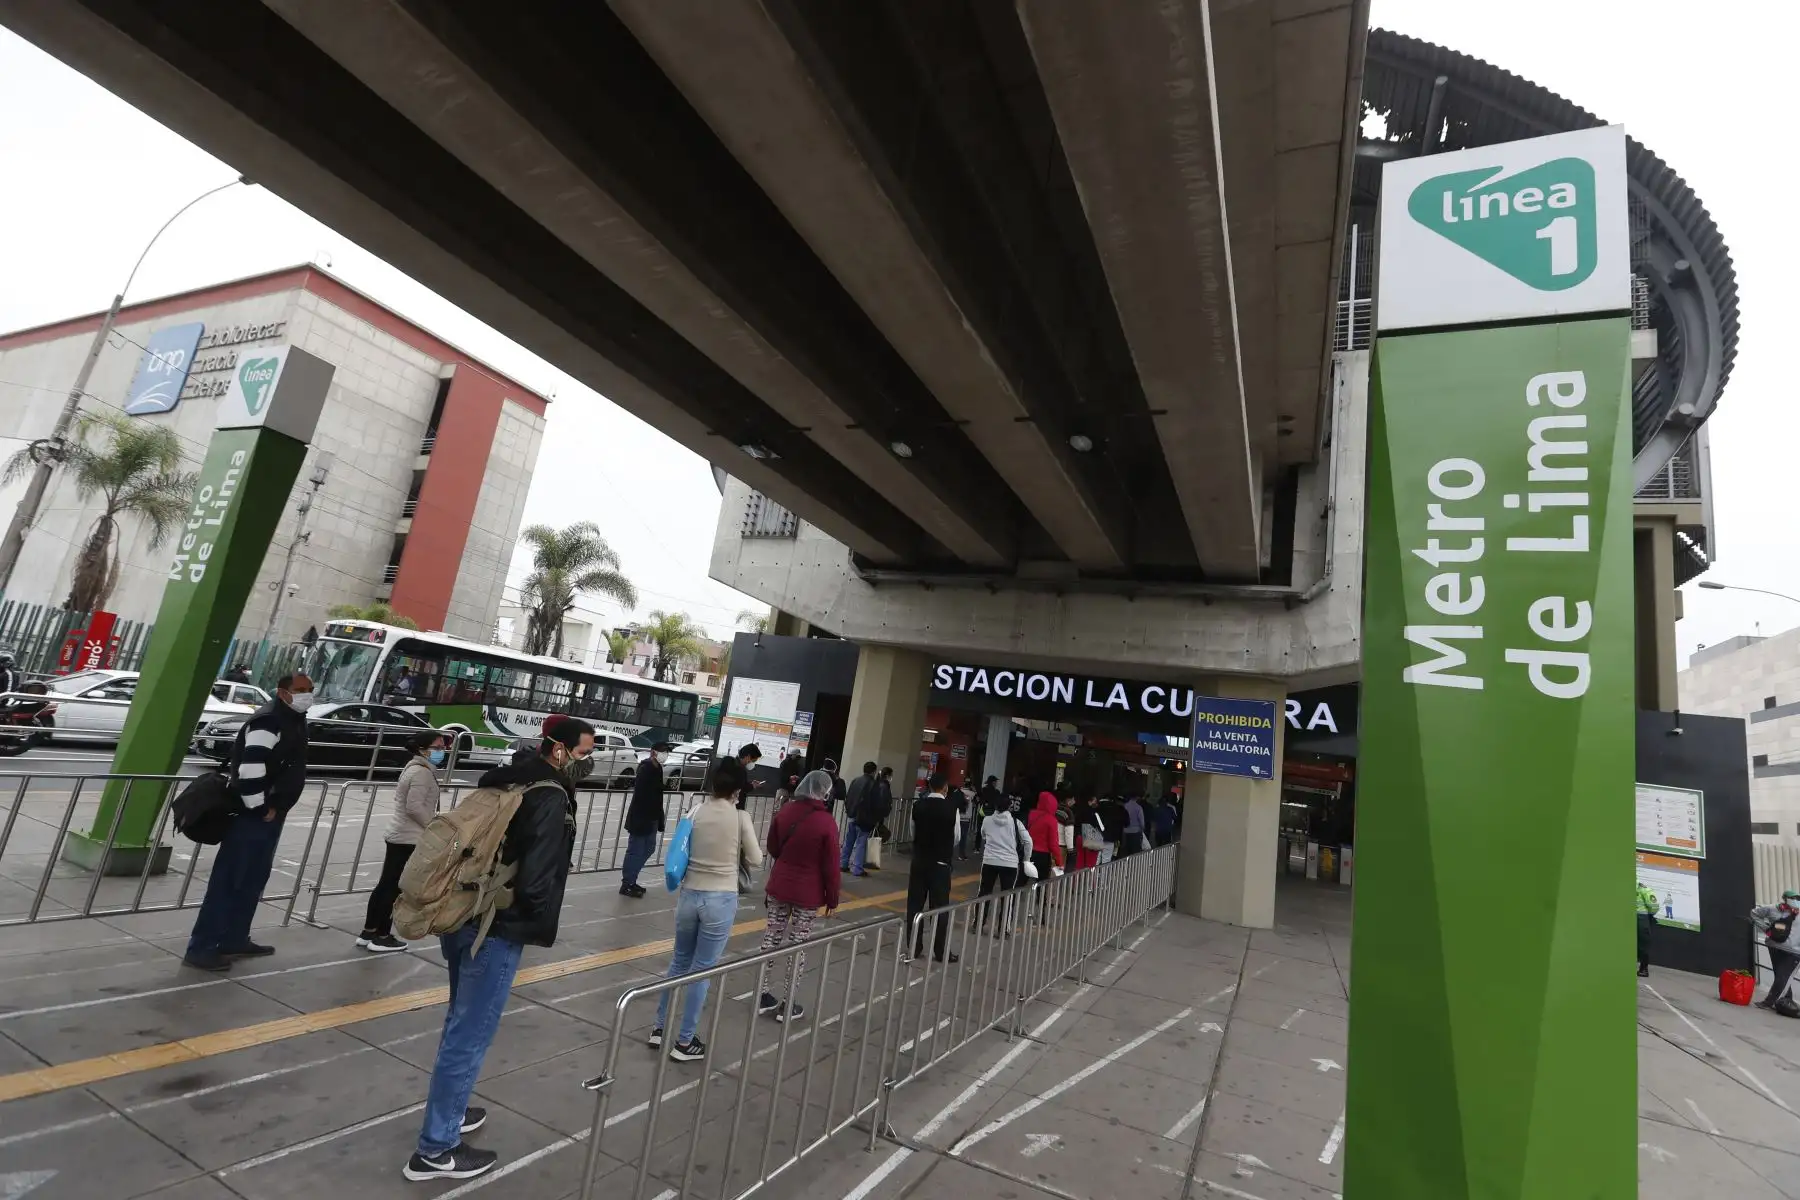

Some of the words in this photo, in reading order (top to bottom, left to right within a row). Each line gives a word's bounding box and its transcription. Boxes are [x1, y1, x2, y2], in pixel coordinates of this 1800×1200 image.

[1536, 216, 1578, 276] 1
[200, 350, 238, 372] nacio
[254, 383, 269, 410] 1
[1503, 370, 1590, 552] Lima
[168, 485, 213, 581] Metro
[189, 542, 213, 582] de
[205, 451, 246, 526] Lima
[1403, 458, 1486, 690] Metro
[84, 645, 103, 671] laro
[1504, 596, 1592, 699] de
[930, 663, 1074, 704] STACION
[1085, 679, 1130, 711] LA
[1140, 686, 1339, 733] CURA
[1198, 712, 1271, 729] PROHIBIDA
[1196, 740, 1270, 756] AMBULATORIA
[1209, 730, 1221, 740] LA
[1224, 731, 1258, 743] VENTA
